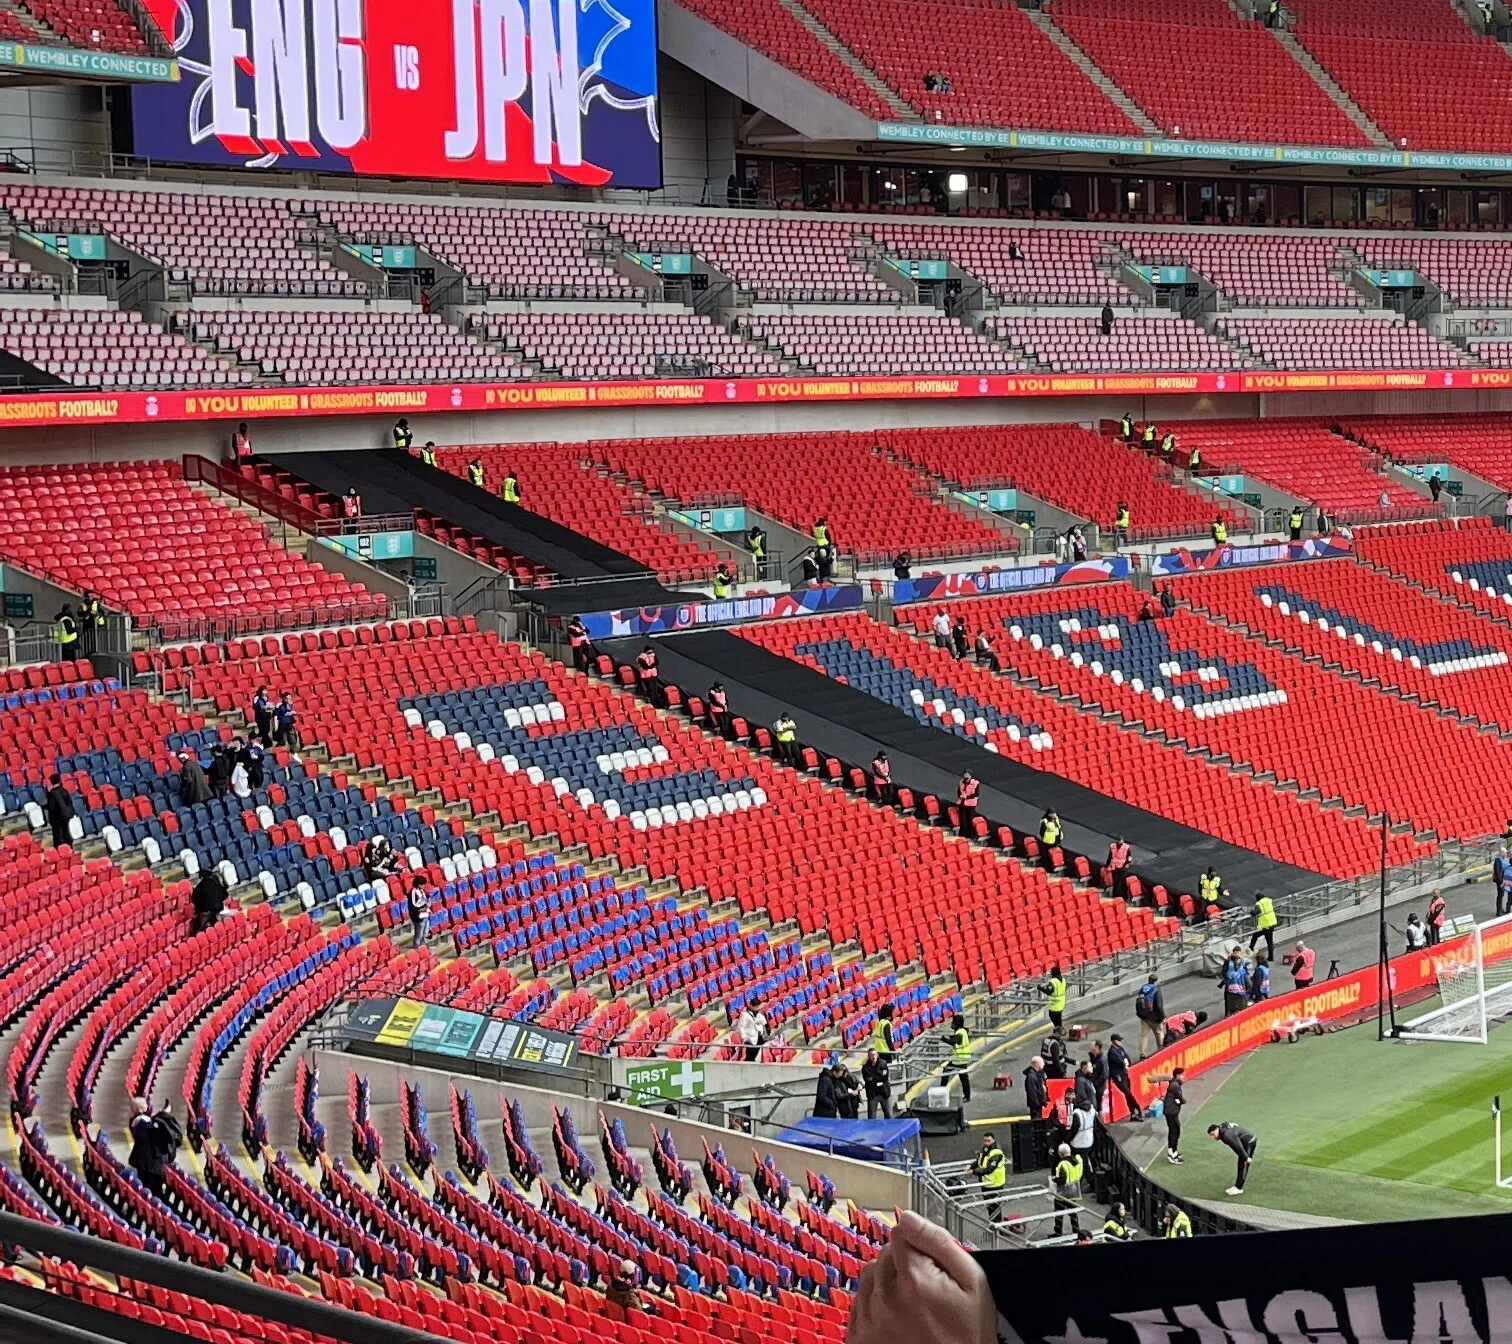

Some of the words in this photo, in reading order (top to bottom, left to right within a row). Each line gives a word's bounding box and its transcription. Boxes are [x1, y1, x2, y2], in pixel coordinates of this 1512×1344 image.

[27, 51, 87, 68] WEMBLEY
[91, 58, 167, 75] CONNECTED
[395, 45, 419, 90] VS
[880, 126, 926, 139] WEMBLEY
[928, 129, 983, 141] CONNECTED
[1019, 134, 1060, 145] WEMBLEY
[1064, 137, 1118, 148] CONNECTED
[1154, 142, 1194, 153] WEMBLEY
[1197, 145, 1250, 157] CONNECTED
[1018, 379, 1052, 390] YOU
[1255, 376, 1284, 387] YOU
[1481, 373, 1512, 383] YOU
[497, 389, 533, 403] YOU
[535, 388, 586, 401] VOLUNTEER
[655, 385, 704, 398] FOOTBALL?
[768, 383, 801, 396] YOU
[912, 380, 959, 393] FOOTBALL?
[59, 400, 118, 417] FOOTBALL?
[198, 397, 239, 412] YOU
[241, 395, 298, 411] VOLUNTEER
[310, 393, 373, 408] GRASSROOTS
[375, 392, 427, 406] FOOTBALL?
[1185, 1029, 1230, 1069] VOLUNTEER
[1304, 982, 1360, 1017] FOOTBALL?
[628, 1067, 668, 1086] FIRST
[637, 1084, 661, 1101] AID
